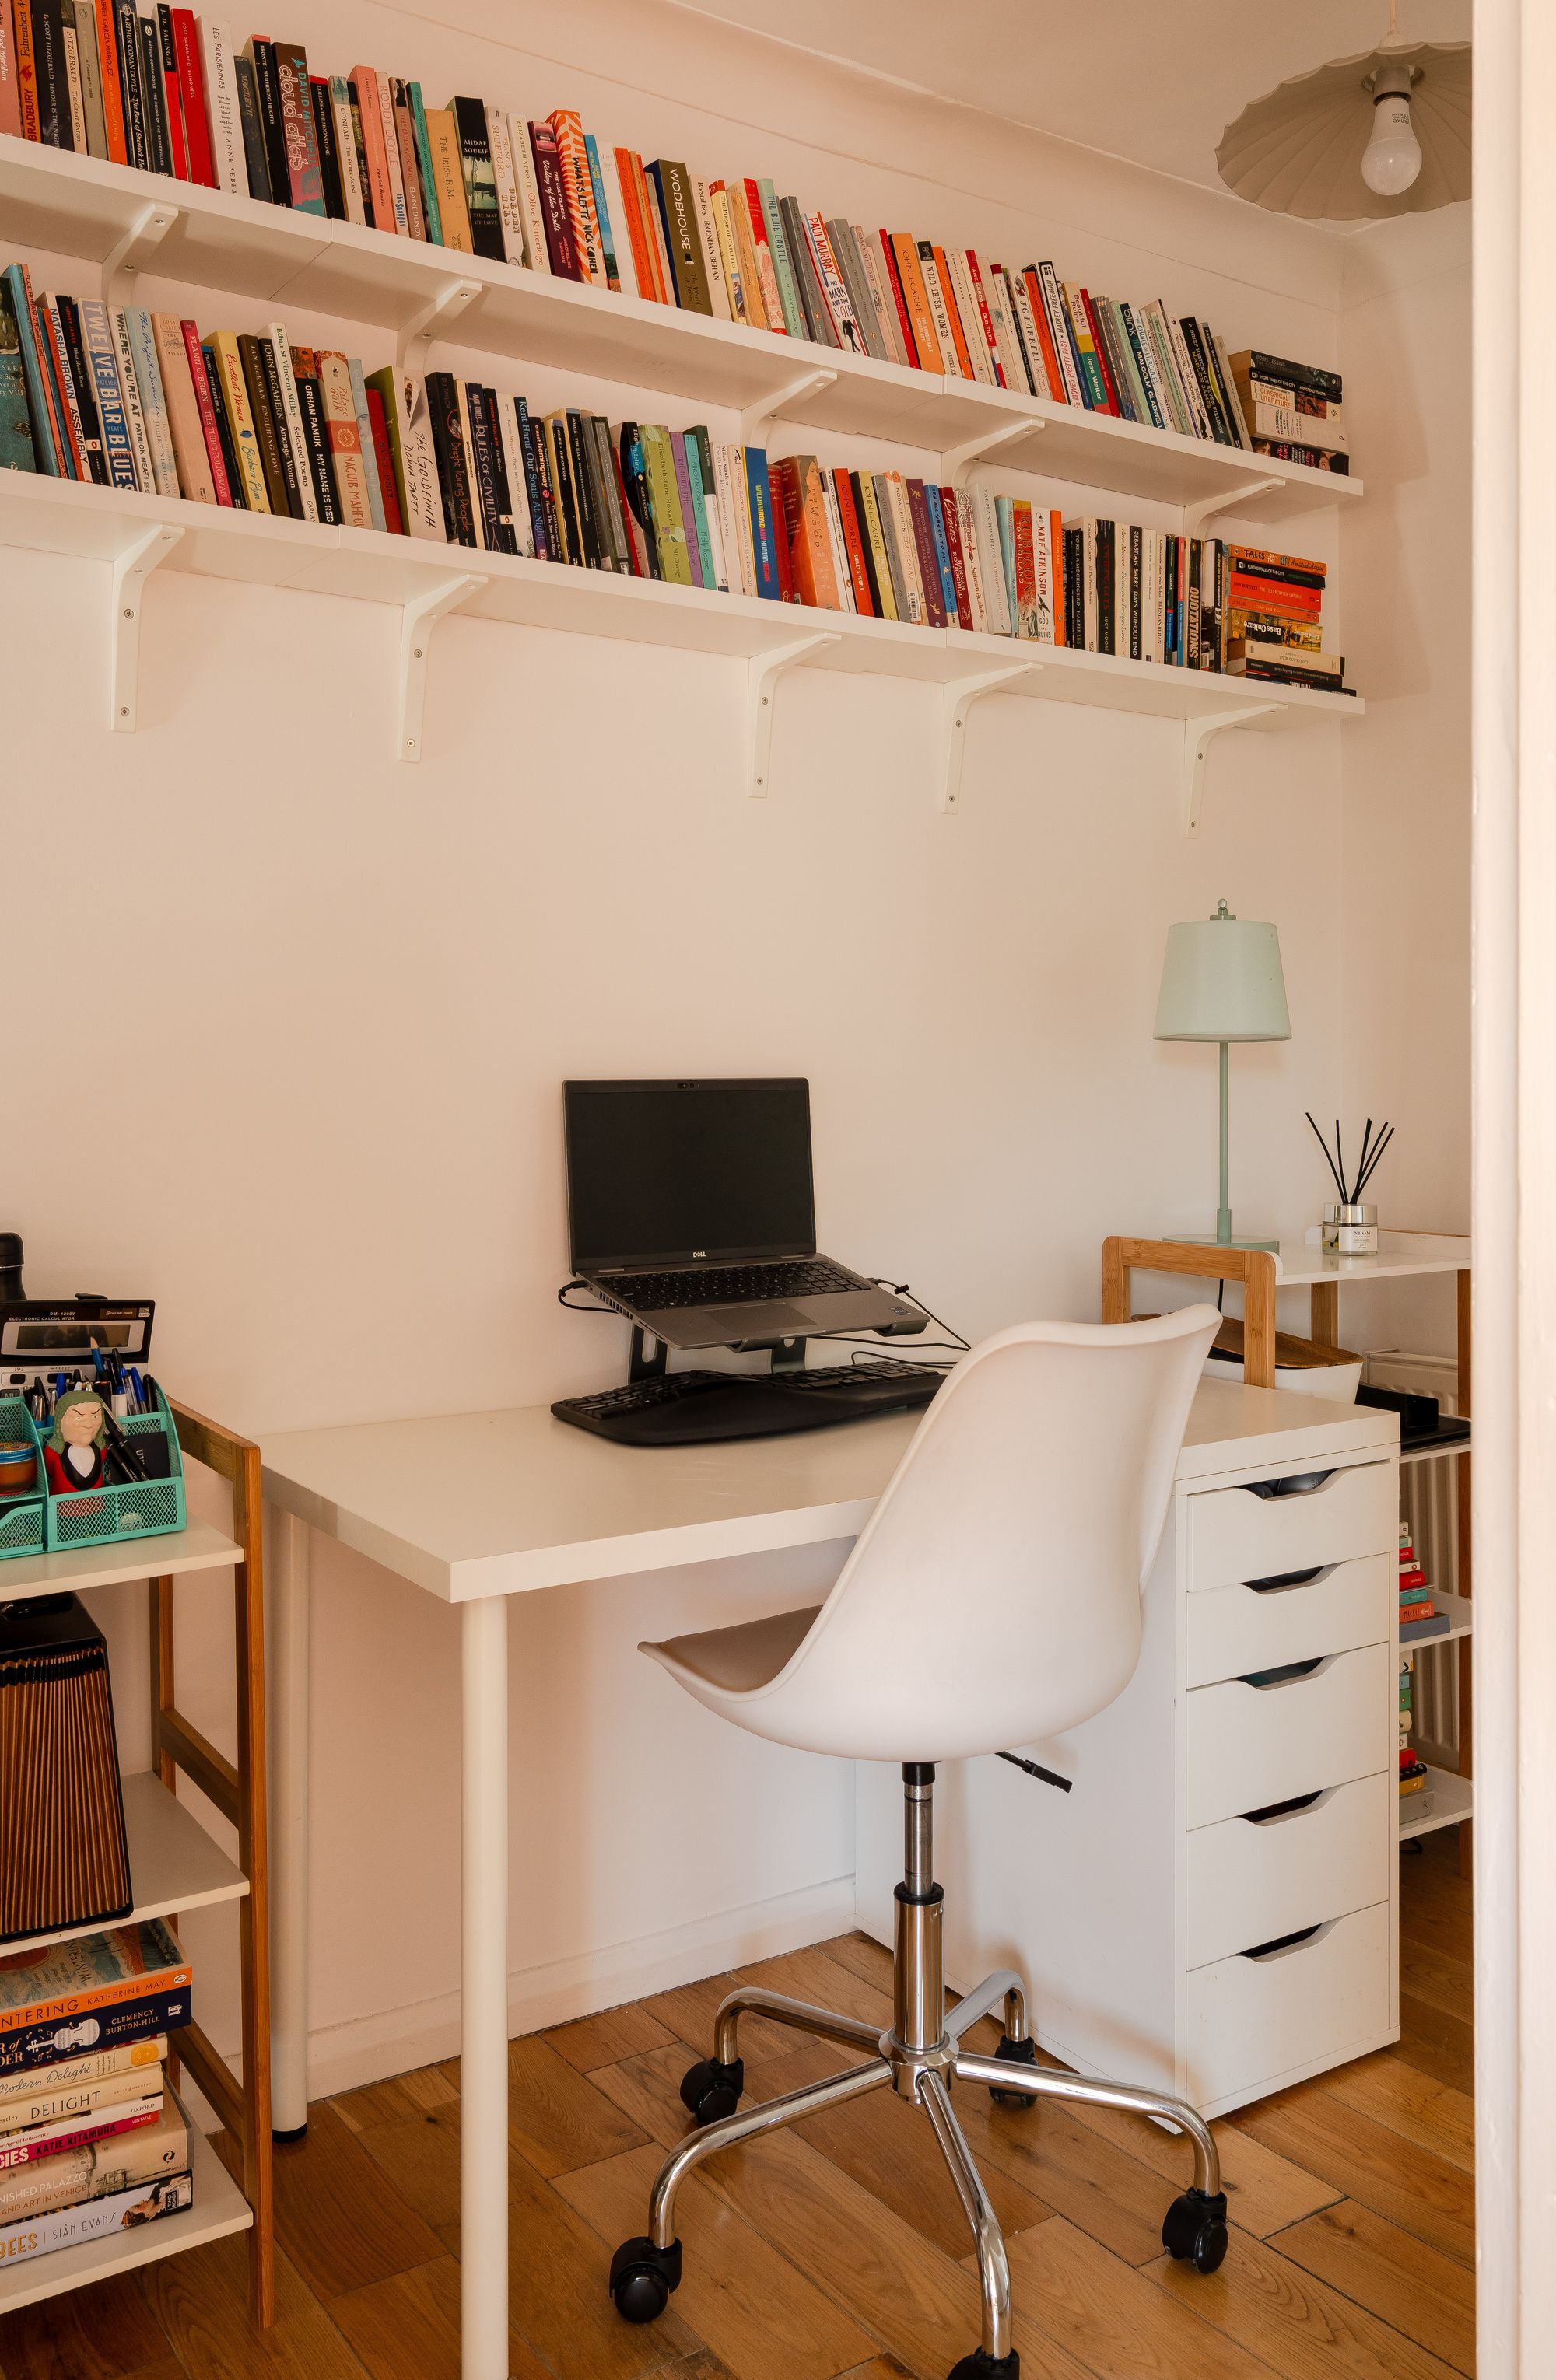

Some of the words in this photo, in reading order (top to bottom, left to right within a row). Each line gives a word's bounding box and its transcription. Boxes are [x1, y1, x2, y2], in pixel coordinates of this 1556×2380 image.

[19, 11, 30, 58] Fahrenheit
[163, 30, 173, 67] SALINGER
[46, 41, 54, 79] FITZGERALD
[66, 31, 78, 82] FITZGERALD
[213, 42, 226, 89] PARISIENNES
[279, 65, 303, 119] cloud
[297, 72, 310, 107] DAVID
[26, 88, 37, 142] BRADBURY
[379, 86, 393, 130] RODDY
[340, 107, 350, 141] CONRAD
[135, 133, 145, 160] Sherlock
[226, 138, 236, 163] ANNE
[385, 129, 398, 167] DOYLE
[492, 125, 505, 180] SPUFFORD
[517, 121, 526, 159] ELIZABETH
[229, 166, 237, 194] SEBBA
[441, 156, 451, 177] IRISH
[523, 160, 531, 188] STROUT
[408, 187, 418, 210] ELAINE
[527, 192, 536, 217] Olive
[670, 168, 691, 250] WODEHOUSE
[766, 195, 776, 211] THE
[412, 211, 422, 238] DUNDY
[551, 209, 562, 232] Dolls
[583, 225, 593, 244] NICK
[770, 212, 781, 236] BLUE
[531, 219, 544, 266] Kitteridge
[704, 220, 716, 254] BRENDAN
[710, 254, 720, 281] BEHAN
[773, 236, 787, 264] CASTLE
[808, 216, 822, 238] PAUL
[815, 240, 836, 275] MURRAY
[586, 245, 598, 274] COHEN
[902, 248, 912, 272] JOHN
[927, 266, 936, 285] WILD
[829, 286, 846, 299] MARK
[931, 289, 942, 310] IRISH
[975, 282, 986, 308] GARDAM
[1046, 279, 1059, 310] FREEMAN
[833, 306, 853, 318] VOID
[1053, 310, 1064, 334] HADLEY
[1071, 300, 1080, 324] Ruins
[1074, 294, 1087, 328] Beautiful
[1123, 308, 1136, 337] blink
[117, 313, 130, 356] WHERE
[937, 313, 950, 340] WOMEN
[1190, 329, 1199, 348] BRIEF
[263, 344, 273, 368] JOHN
[1136, 351, 1151, 389] MALCOLM
[49, 307, 65, 355] NATASHA
[60, 357, 75, 400] BROWN
[69, 408, 89, 464] ASSEMBLY
[282, 359, 293, 389] Vincent
[1087, 355, 1095, 375] Jess
[1092, 375, 1102, 401] Walter
[286, 389, 296, 419] Millay
[304, 383, 317, 415] ORHAN
[330, 386, 341, 413] Walk
[338, 385, 349, 418] Palace
[1260, 387, 1289, 401] CLASSICAL
[1260, 395, 1291, 408] LITERATURE
[131, 402, 141, 418] AT
[190, 334, 202, 365] FLANN
[208, 426, 217, 450] THIRD
[213, 450, 228, 499] POLICEMAN
[518, 400, 527, 422] Kent
[135, 422, 145, 455] PATRICK
[293, 425, 304, 460] Selected
[310, 416, 322, 448] PAMUK
[521, 422, 532, 450] Haruf
[279, 425, 290, 459] Amongst
[286, 459, 296, 488] Women
[317, 453, 324, 467] MY
[403, 443, 415, 477] DONNA
[526, 453, 534, 471] Our
[538, 443, 548, 488] hemingway
[299, 460, 309, 488] Poems
[319, 467, 329, 494] NAME
[342, 455, 359, 488] NAGUIB
[658, 443, 668, 480] Elizabeth
[665, 495, 675, 527] Howard
[408, 478, 419, 516] TARTT
[528, 473, 539, 499] Souls
[864, 485, 873, 509] JOHN
[325, 505, 334, 523] RED
[482, 476, 499, 527] CIVILITY
[534, 512, 546, 541] Night
[1037, 525, 1046, 548] KATE
[1020, 513, 1035, 592] RUBICON
[1243, 548, 1266, 562] TALES
[952, 551, 963, 599] ROTHSCHILD
[957, 559, 966, 591] HANNAH
[1038, 551, 1048, 597] ATKINSON
[1188, 586, 1200, 659] QUOTATIONS
[1243, 621, 1267, 633] Culture
[1265, 625, 1282, 635] Bass
[2, 2000, 79, 2029] NTERING
[87, 1986, 141, 2005] KATHERINE
[145, 1979, 166, 1993] MAY
[110, 2008, 155, 2025] CLEMENCY
[105, 2016, 160, 2035] BURTON-HILL
[9, 2038, 23, 2050] of
[47, 2063, 93, 2084] Delight
[31, 2091, 101, 2119] DELIGHT
[131, 2103, 156, 2114] OXFORD
[131, 2114, 152, 2125] VINTAGE
[23, 2131, 50, 2142] Innocence
[36, 2138, 65, 2155] KATIE
[67, 2124, 117, 2146] KITAMURA
[39, 2171, 88, 2192] PALAZZO
[2, 2206, 21, 2216] AND
[23, 2200, 40, 2210] ART
[54, 2186, 87, 2200] VENICE
[52, 2223, 77, 2241] SIÂN
[82, 2210, 117, 2232] EVANS
